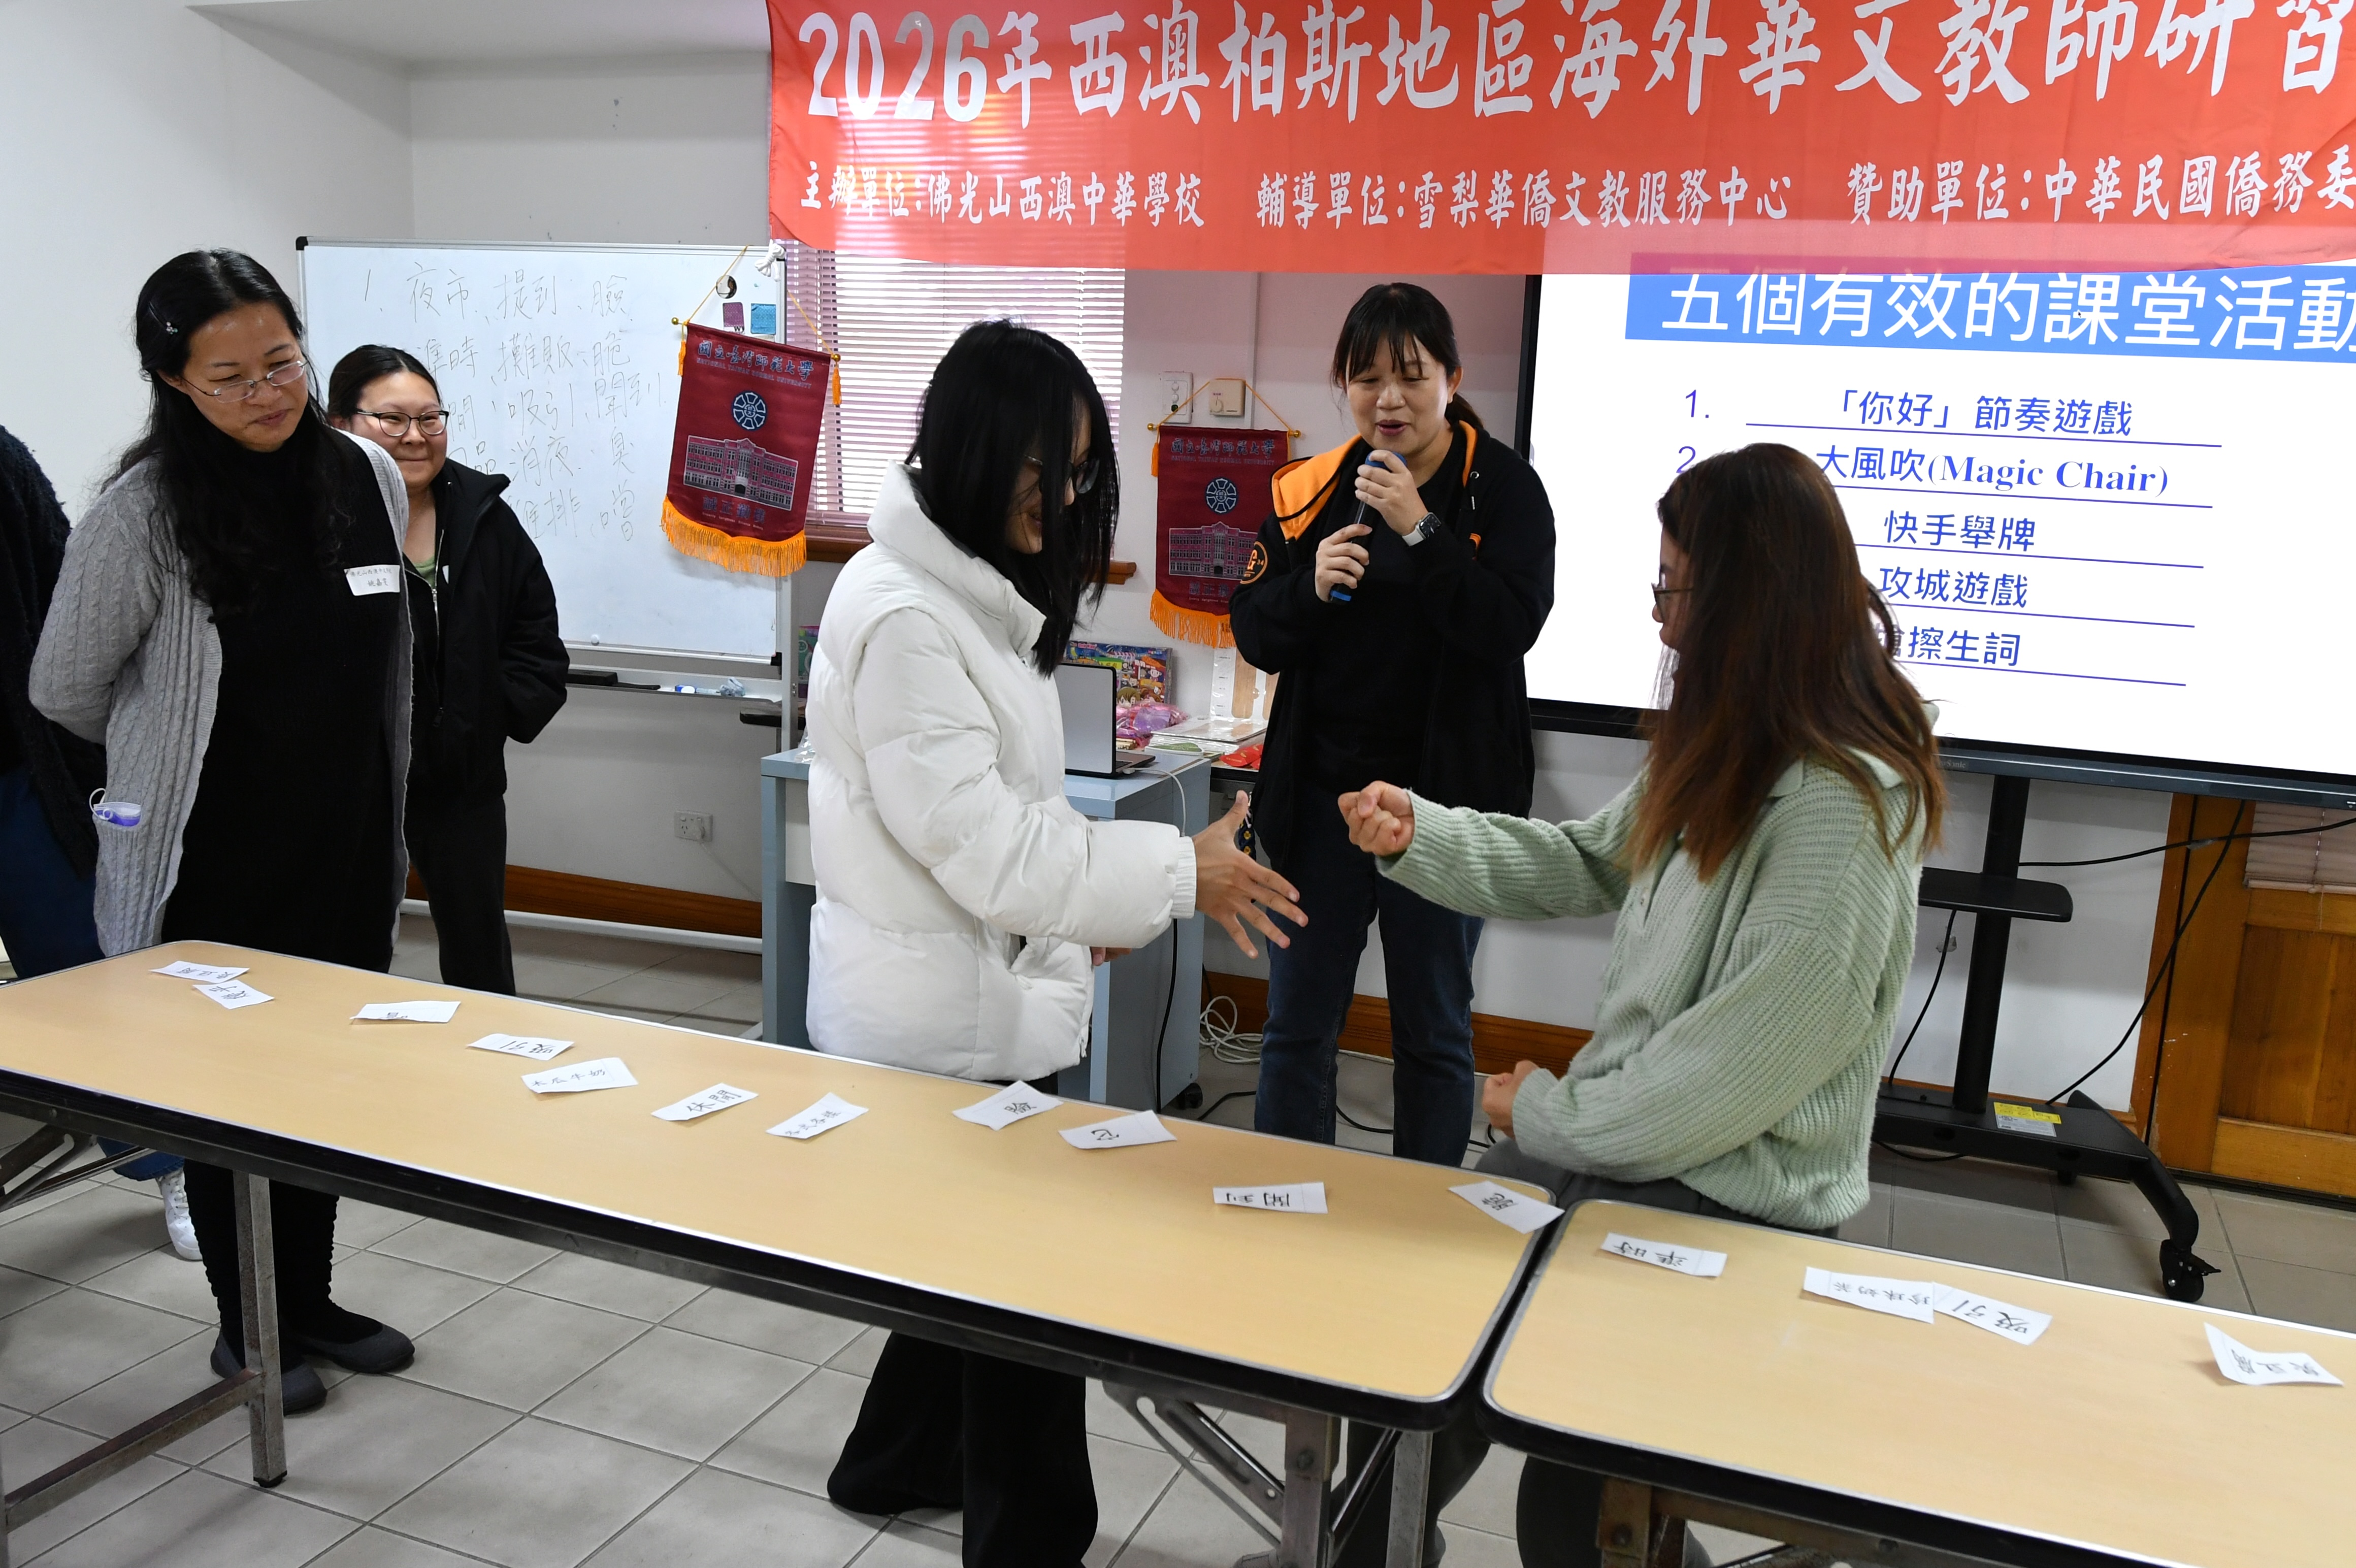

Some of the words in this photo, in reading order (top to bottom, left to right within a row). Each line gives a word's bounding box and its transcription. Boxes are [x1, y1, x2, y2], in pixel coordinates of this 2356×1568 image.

[798, 0, 2355, 129] 2026年西澳柏斯地區海外華文教師研習
[1256, 165, 1792, 230] 輔導單位:雪梨華僑文教服務中心
[1662, 272, 2356, 352] 五個有效的課堂活動
[1685, 389, 1710, 418] 1.
[2056, 461, 2168, 497] Chair)
[1884, 510, 2035, 552] 快手舉牌
[1880, 566, 2027, 608] 攻城遊戲
